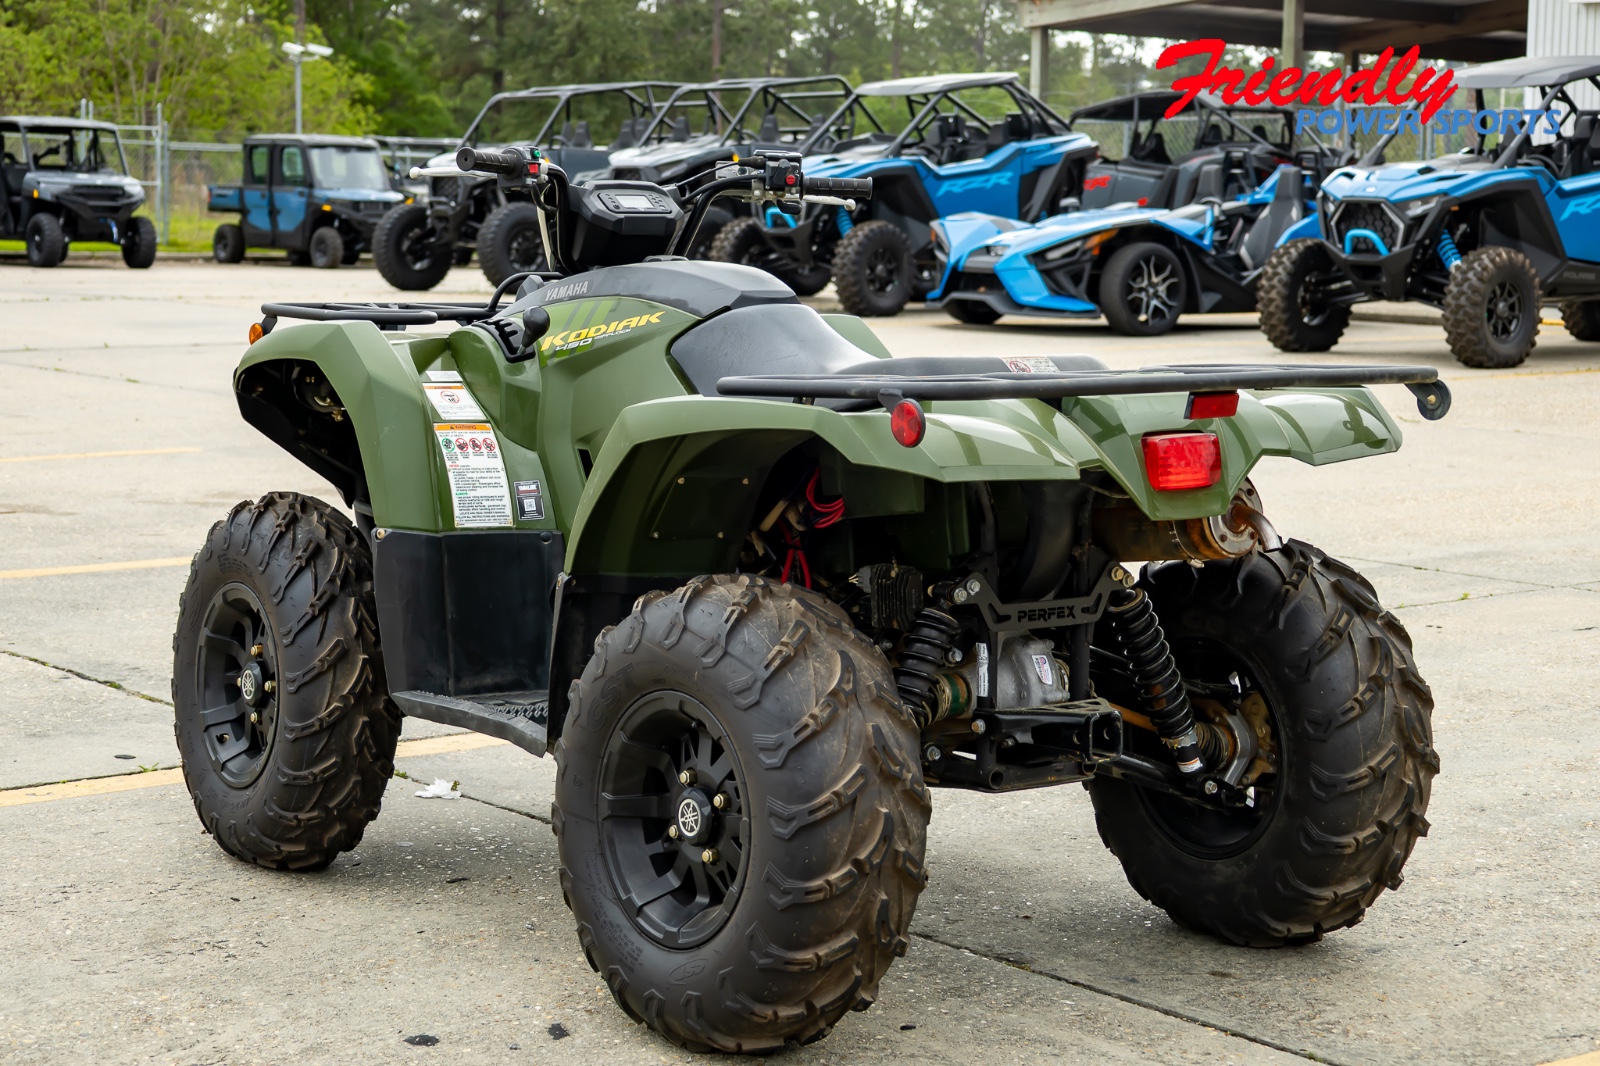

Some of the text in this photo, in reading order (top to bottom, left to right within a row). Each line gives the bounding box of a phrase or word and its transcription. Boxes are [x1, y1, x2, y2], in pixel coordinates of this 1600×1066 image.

[936, 171, 1014, 197] RZR
[545, 280, 589, 302] YAMAHA
[541, 310, 666, 352] KODIAK
[555, 337, 593, 351] 450
[1017, 605, 1077, 623] PERFEX
[587, 662, 634, 732] CST
